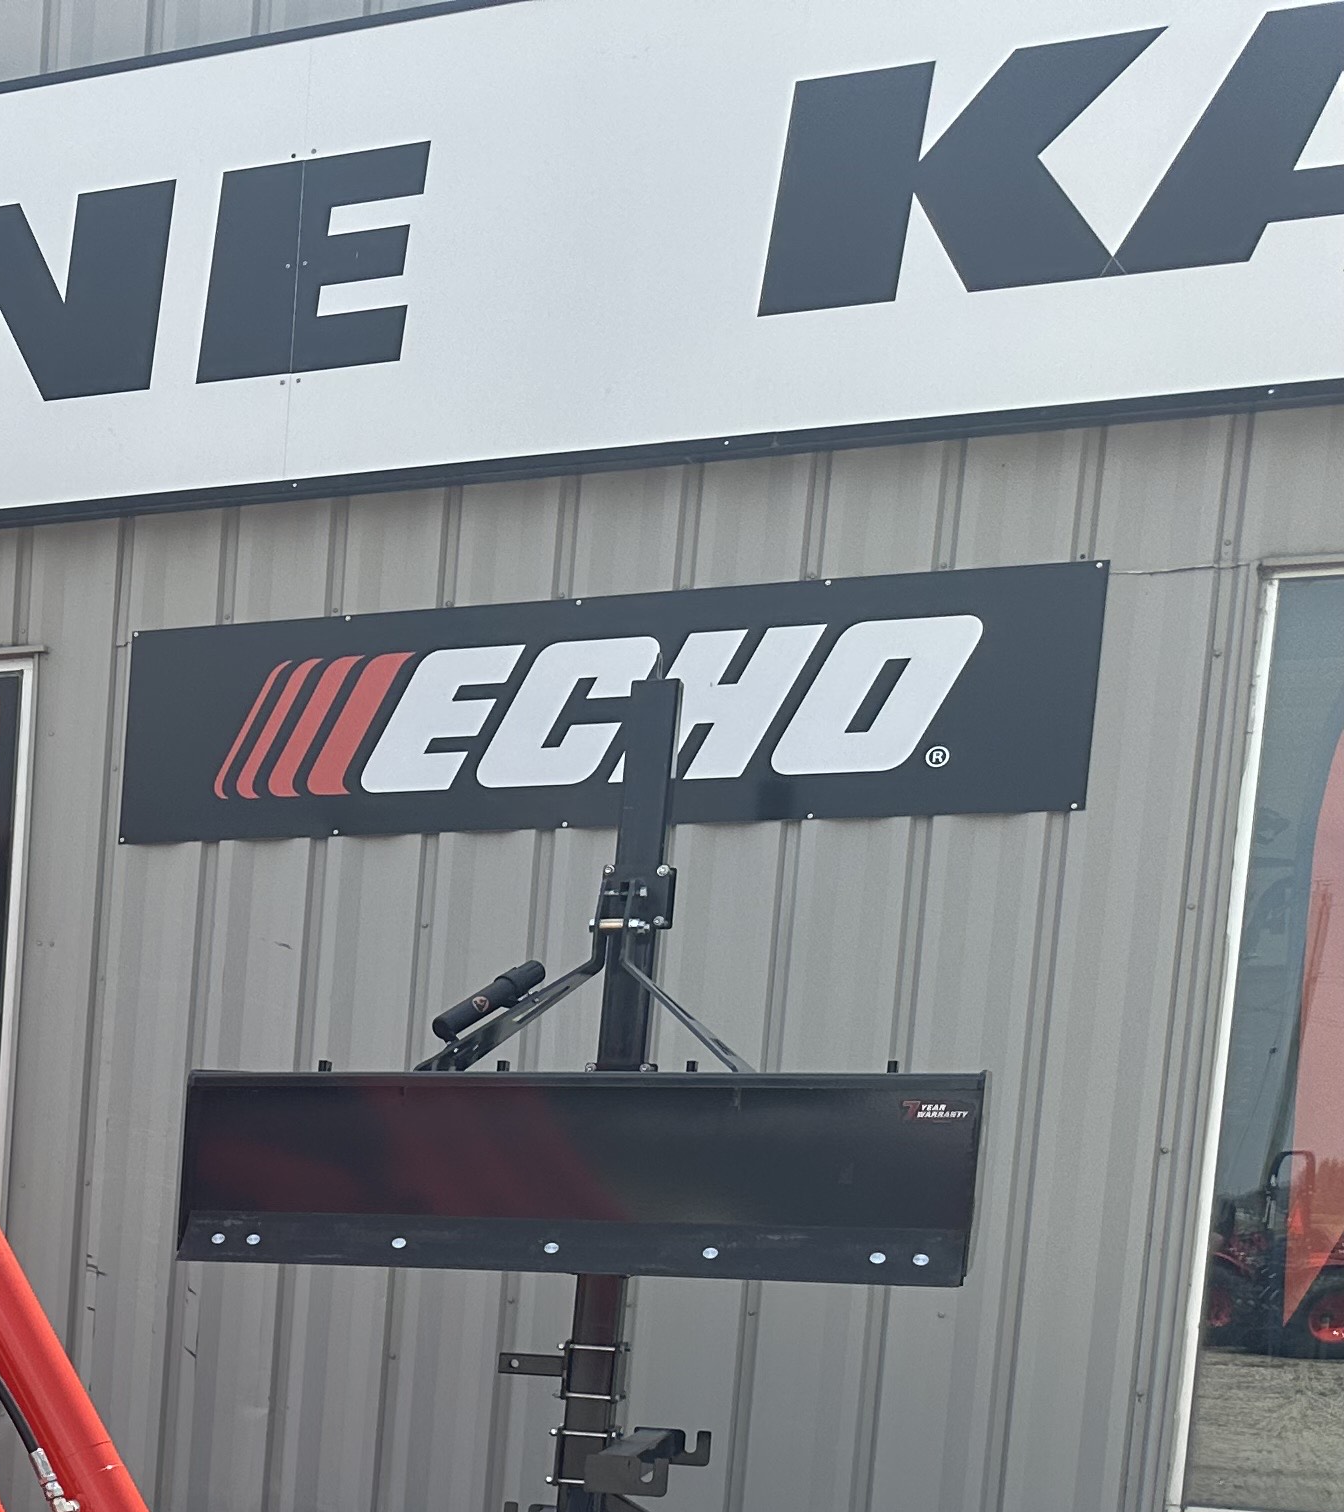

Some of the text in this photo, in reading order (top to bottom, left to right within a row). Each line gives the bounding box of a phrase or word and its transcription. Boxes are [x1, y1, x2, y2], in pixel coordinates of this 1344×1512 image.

[359, 614, 984, 795] ECHO
[920, 1104, 947, 1112] YEAR
[916, 1110, 969, 1119] WARRANTY
